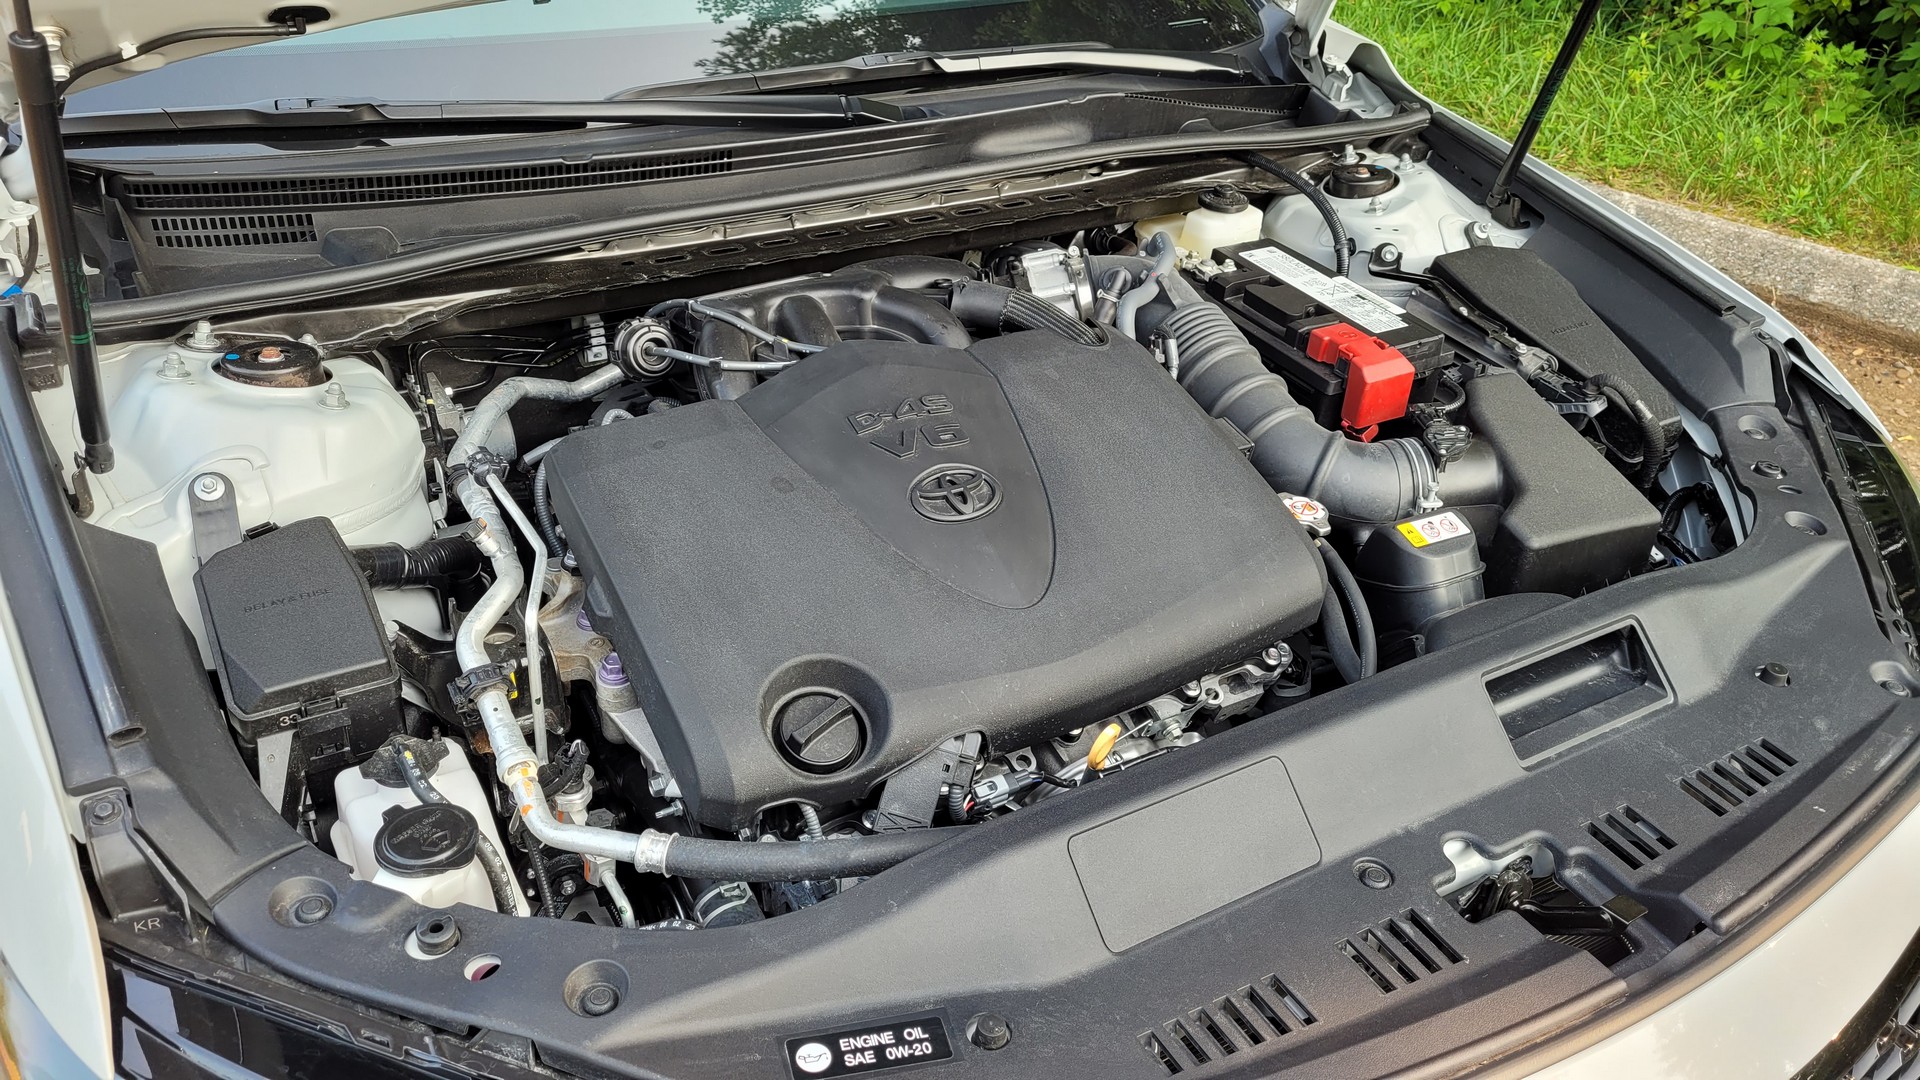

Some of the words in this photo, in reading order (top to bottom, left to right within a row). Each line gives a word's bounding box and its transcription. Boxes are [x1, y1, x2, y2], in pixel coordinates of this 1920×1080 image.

[847, 394, 954, 435] D-4S
[870, 423, 970, 459] V6
[243, 597, 286, 613] RELAY
[299, 588, 333, 600] FUSE
[133, 917, 161, 933] KR
[839, 1031, 895, 1051] ENGINE
[903, 1027, 929, 1041] OIL
[844, 1050, 876, 1067] SAE
[885, 1042, 932, 1060] 0W-20
